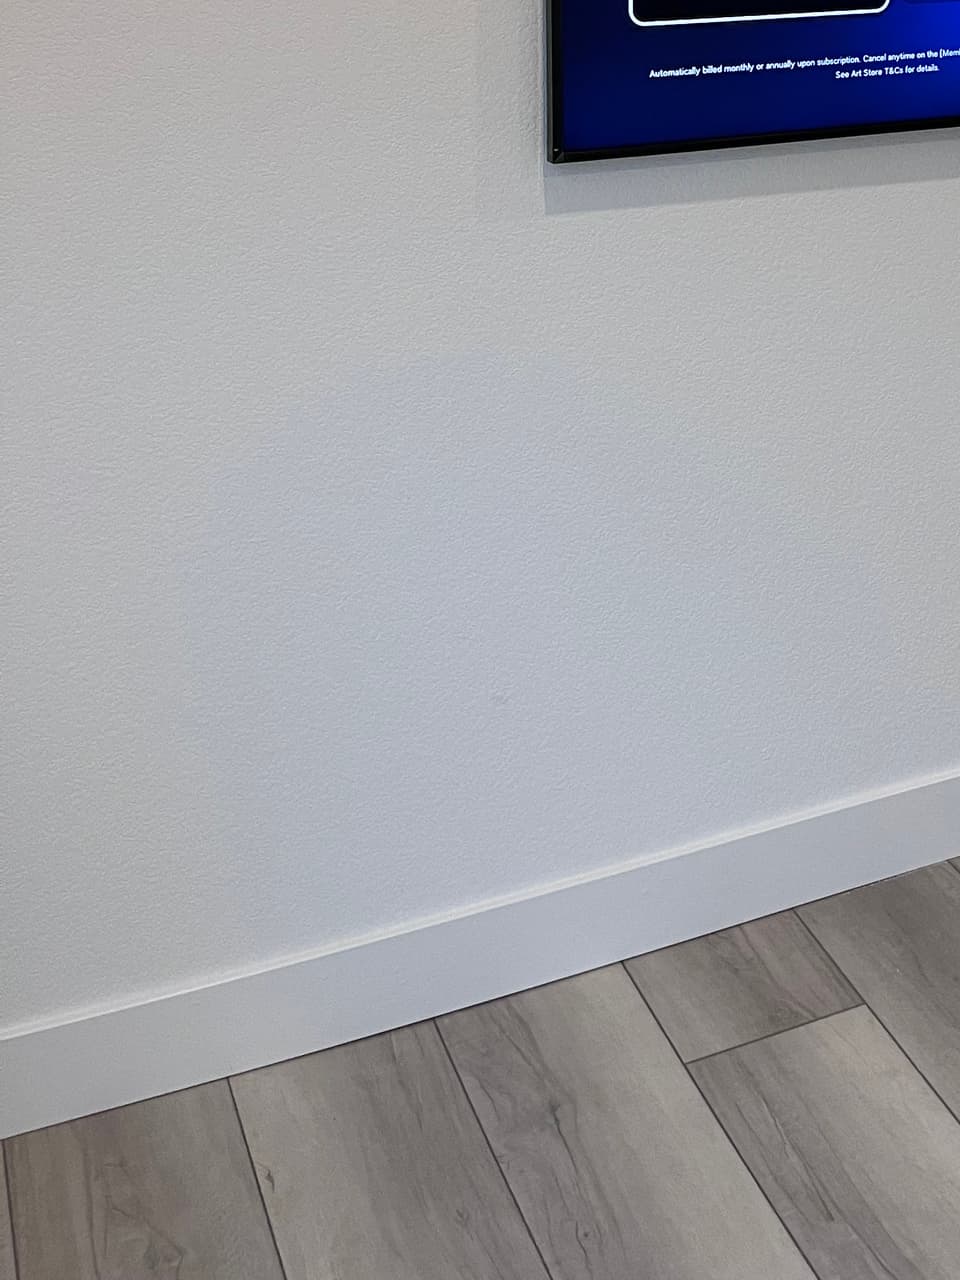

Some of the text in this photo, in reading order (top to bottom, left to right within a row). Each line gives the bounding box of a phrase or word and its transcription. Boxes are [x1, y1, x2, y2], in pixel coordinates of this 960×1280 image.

[649, 67, 701, 78] Automatically
[702, 65, 722, 74] billed
[724, 63, 754, 73] monthly
[766, 60, 795, 69] annually
[797, 59, 815, 68] upon
[863, 53, 887, 63] Cancel
[888, 52, 915, 62] anytime
[916, 51, 925, 59] on
[927, 50, 938, 58] the
[836, 70, 851, 79] See
[852, 68, 862, 78] Art
[863, 68, 883, 77] Store
[885, 66, 903, 75] T&Cs
[905, 65, 915, 74] for
